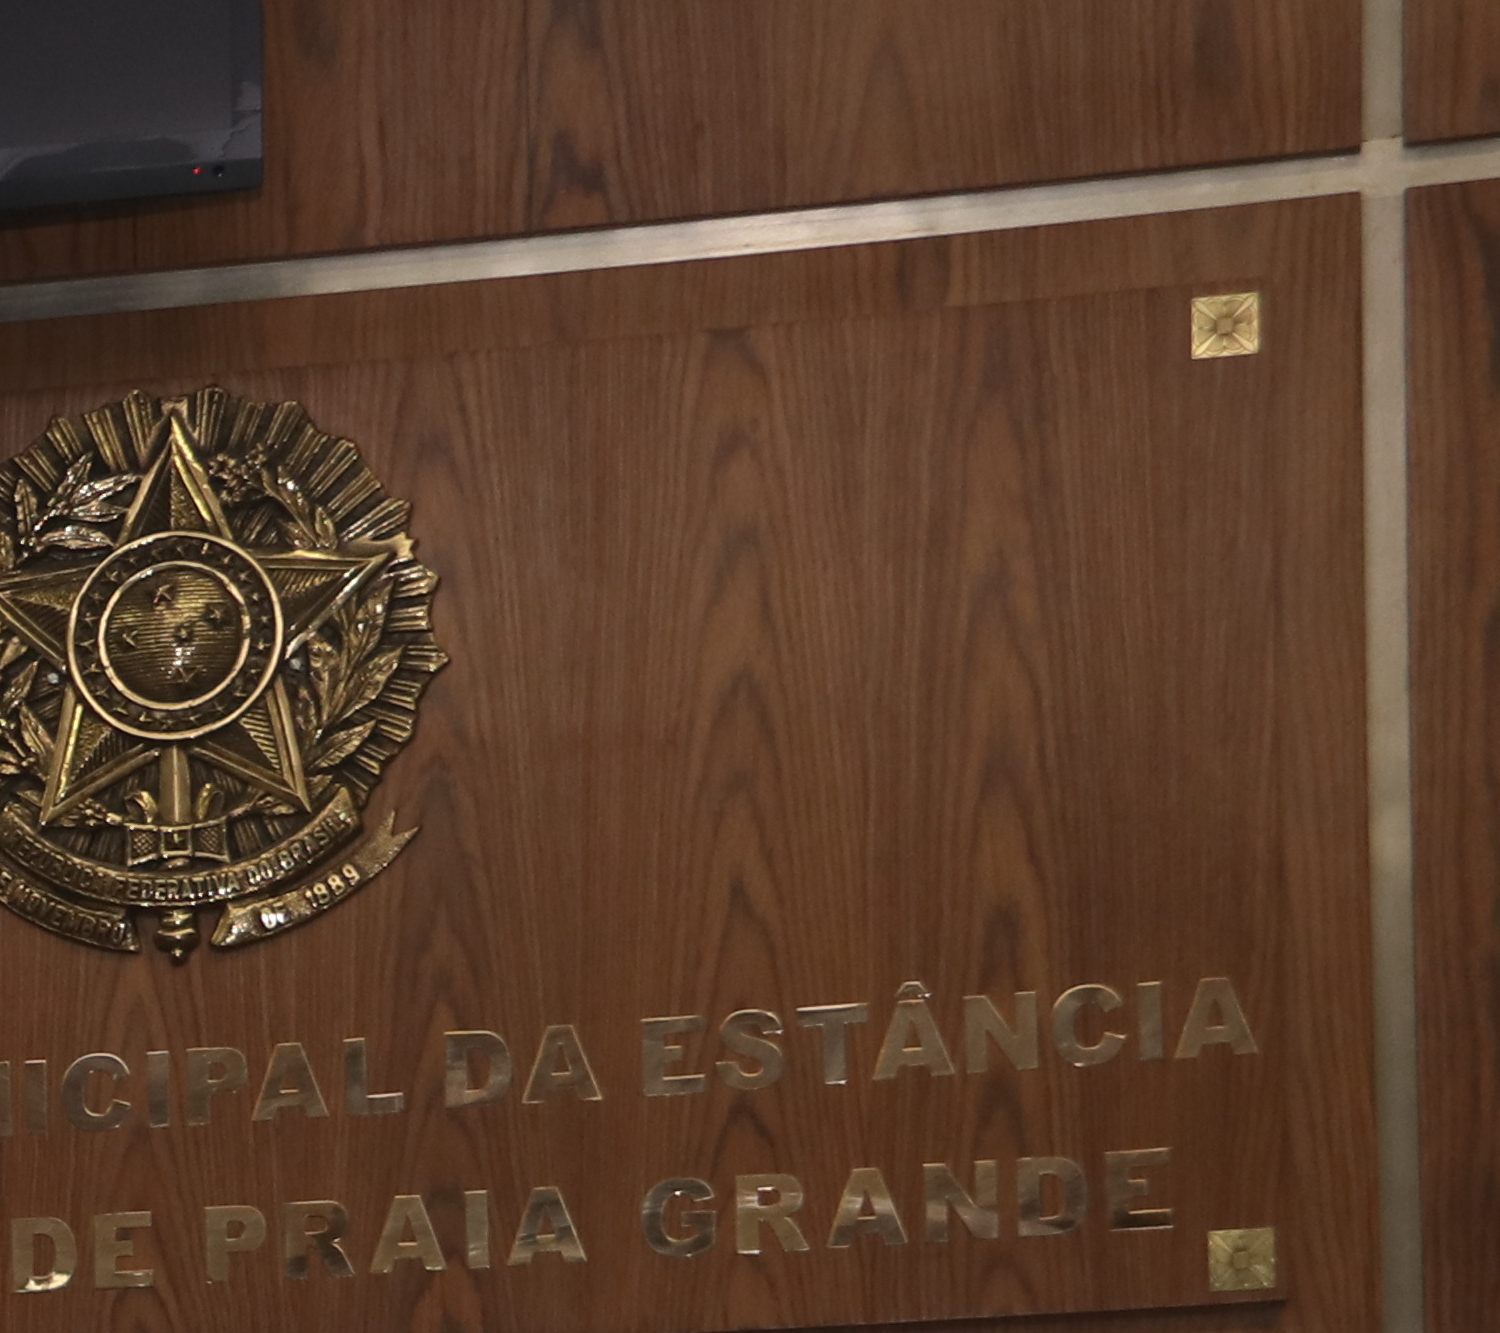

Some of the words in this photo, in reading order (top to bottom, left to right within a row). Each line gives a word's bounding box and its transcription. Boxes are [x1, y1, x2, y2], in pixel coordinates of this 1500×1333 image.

[305, 864, 360, 908] 1889
[443, 1023, 603, 1111] DA
[640, 976, 1258, 1098] ESTÂNCIA
[10, 1210, 155, 1296] DE
[203, 1185, 588, 1284] PRAIA
[640, 1147, 1174, 1259] GRANDE
